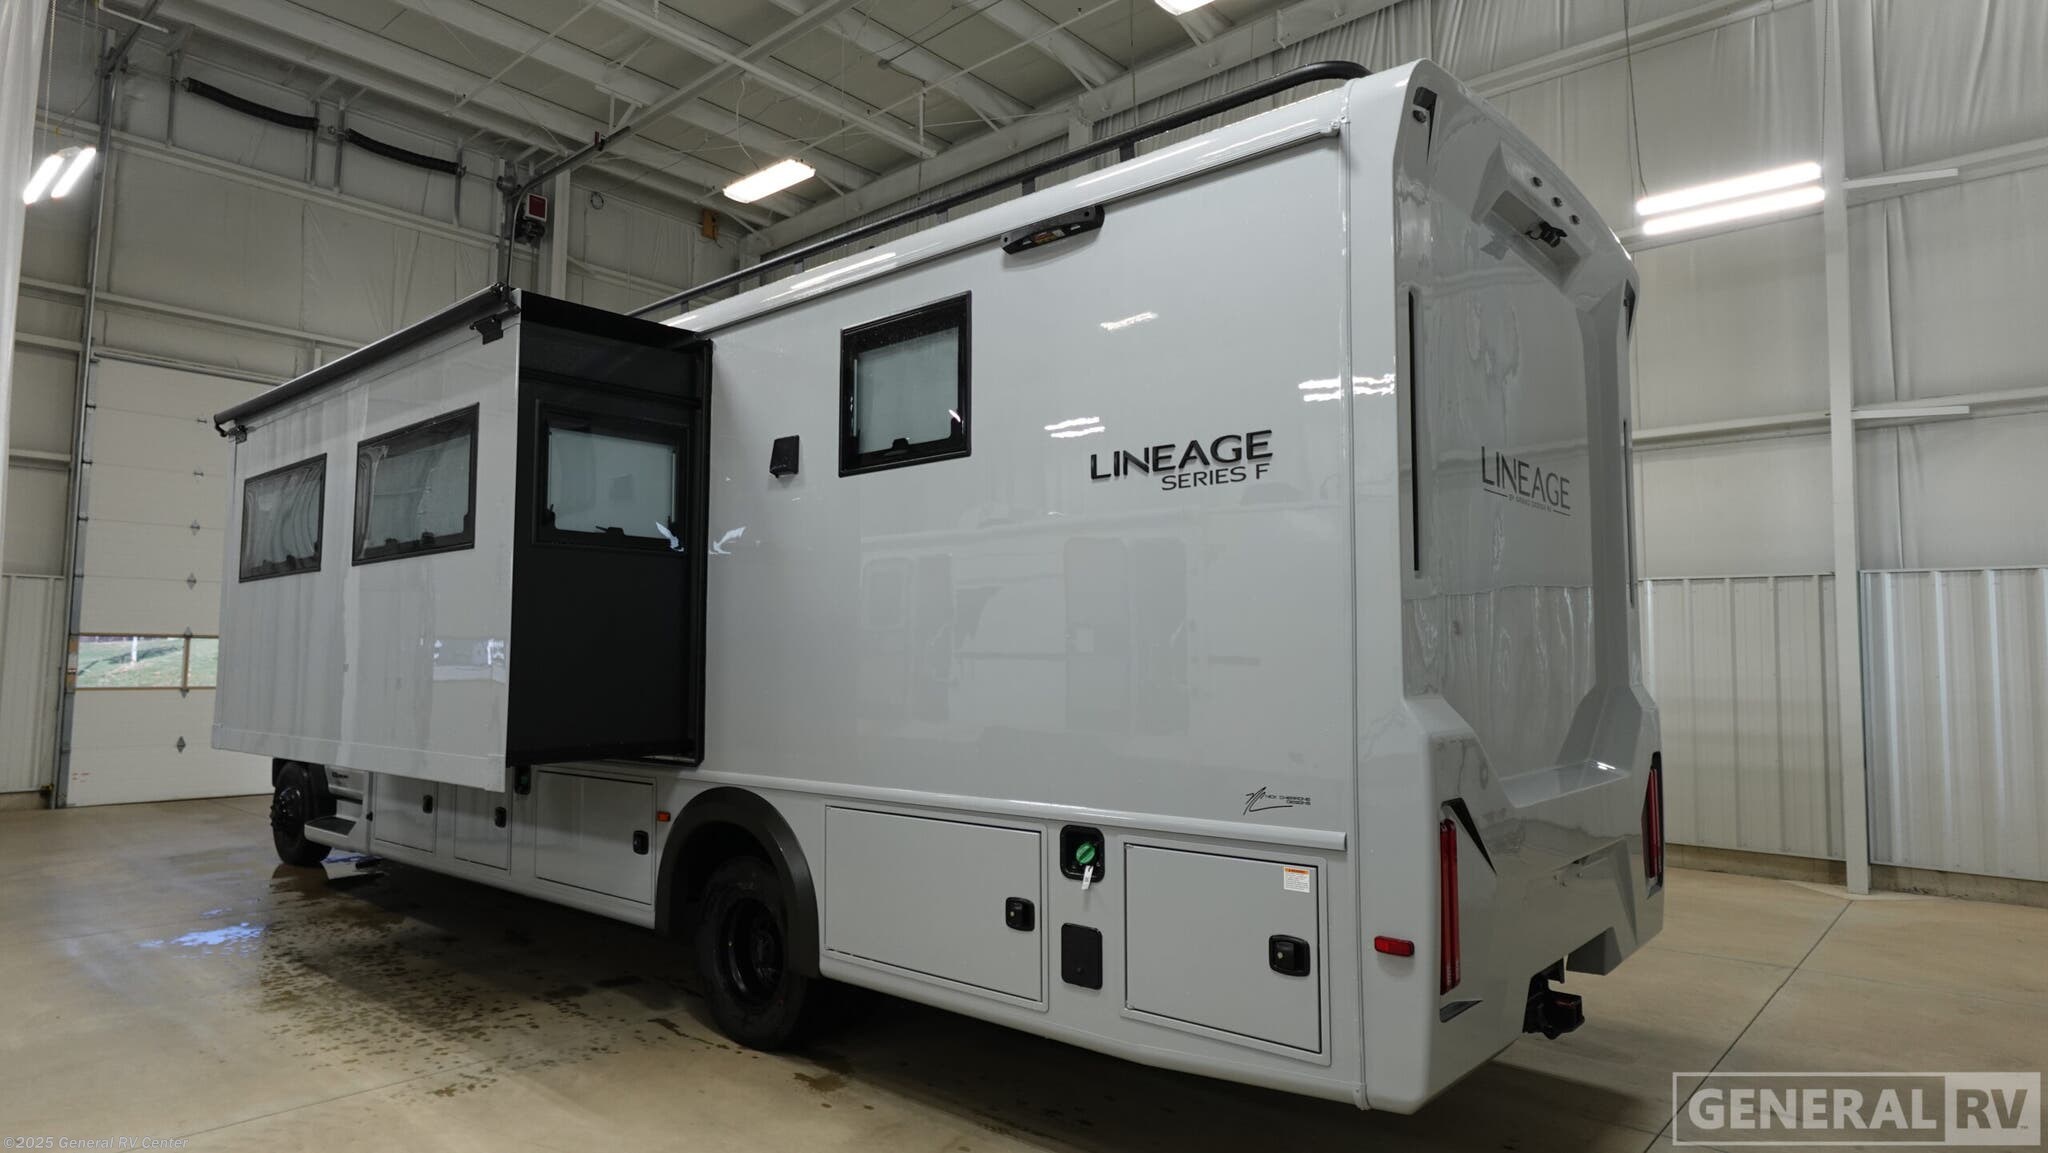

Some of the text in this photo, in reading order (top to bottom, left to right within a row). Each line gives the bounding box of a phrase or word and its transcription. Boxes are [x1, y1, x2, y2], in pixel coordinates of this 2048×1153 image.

[1090, 429, 1273, 480] LINEAGE
[1161, 463, 1270, 491] SERIES F
[1481, 446, 1571, 510] LINEAGE
